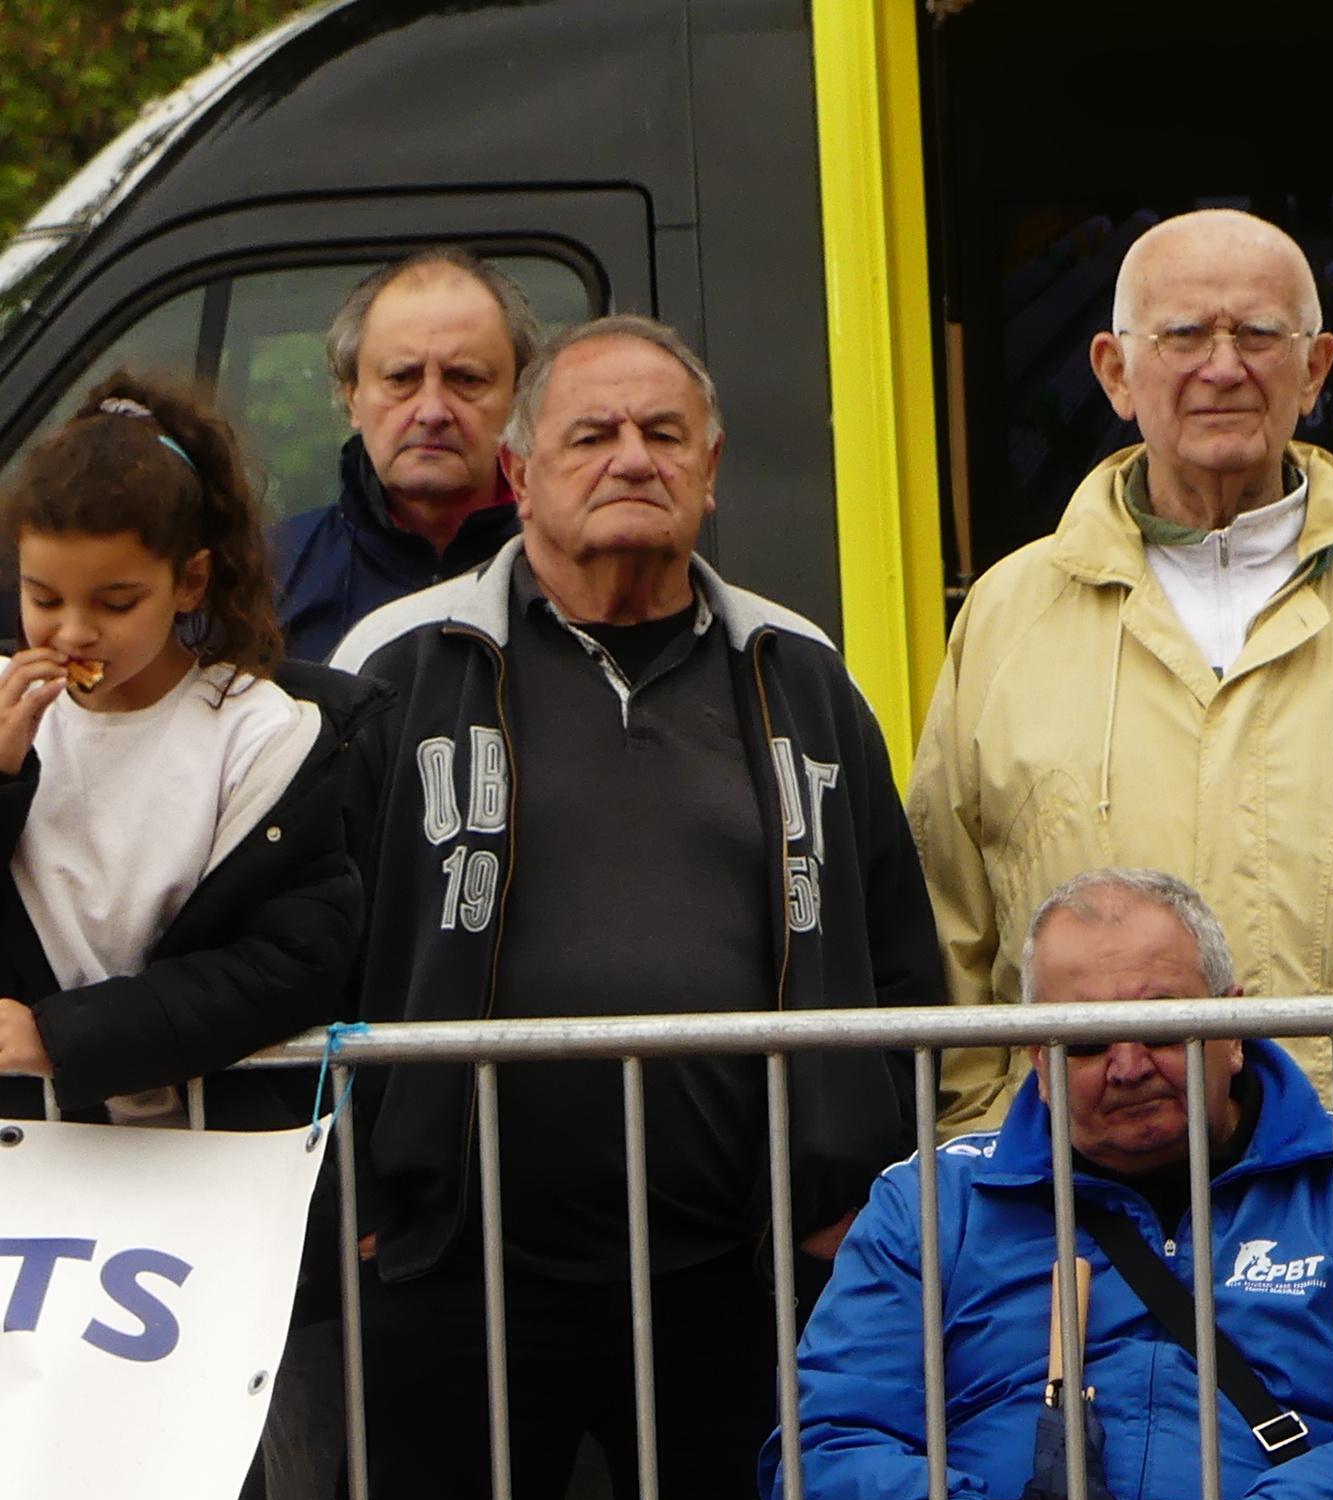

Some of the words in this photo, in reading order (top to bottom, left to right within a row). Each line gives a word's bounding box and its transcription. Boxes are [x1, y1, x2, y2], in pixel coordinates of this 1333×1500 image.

[440, 845, 500, 933] 19
[788, 855, 824, 934] 5
[0, 1237, 194, 1363] TS
[1246, 1255, 1325, 1282] CPBT
